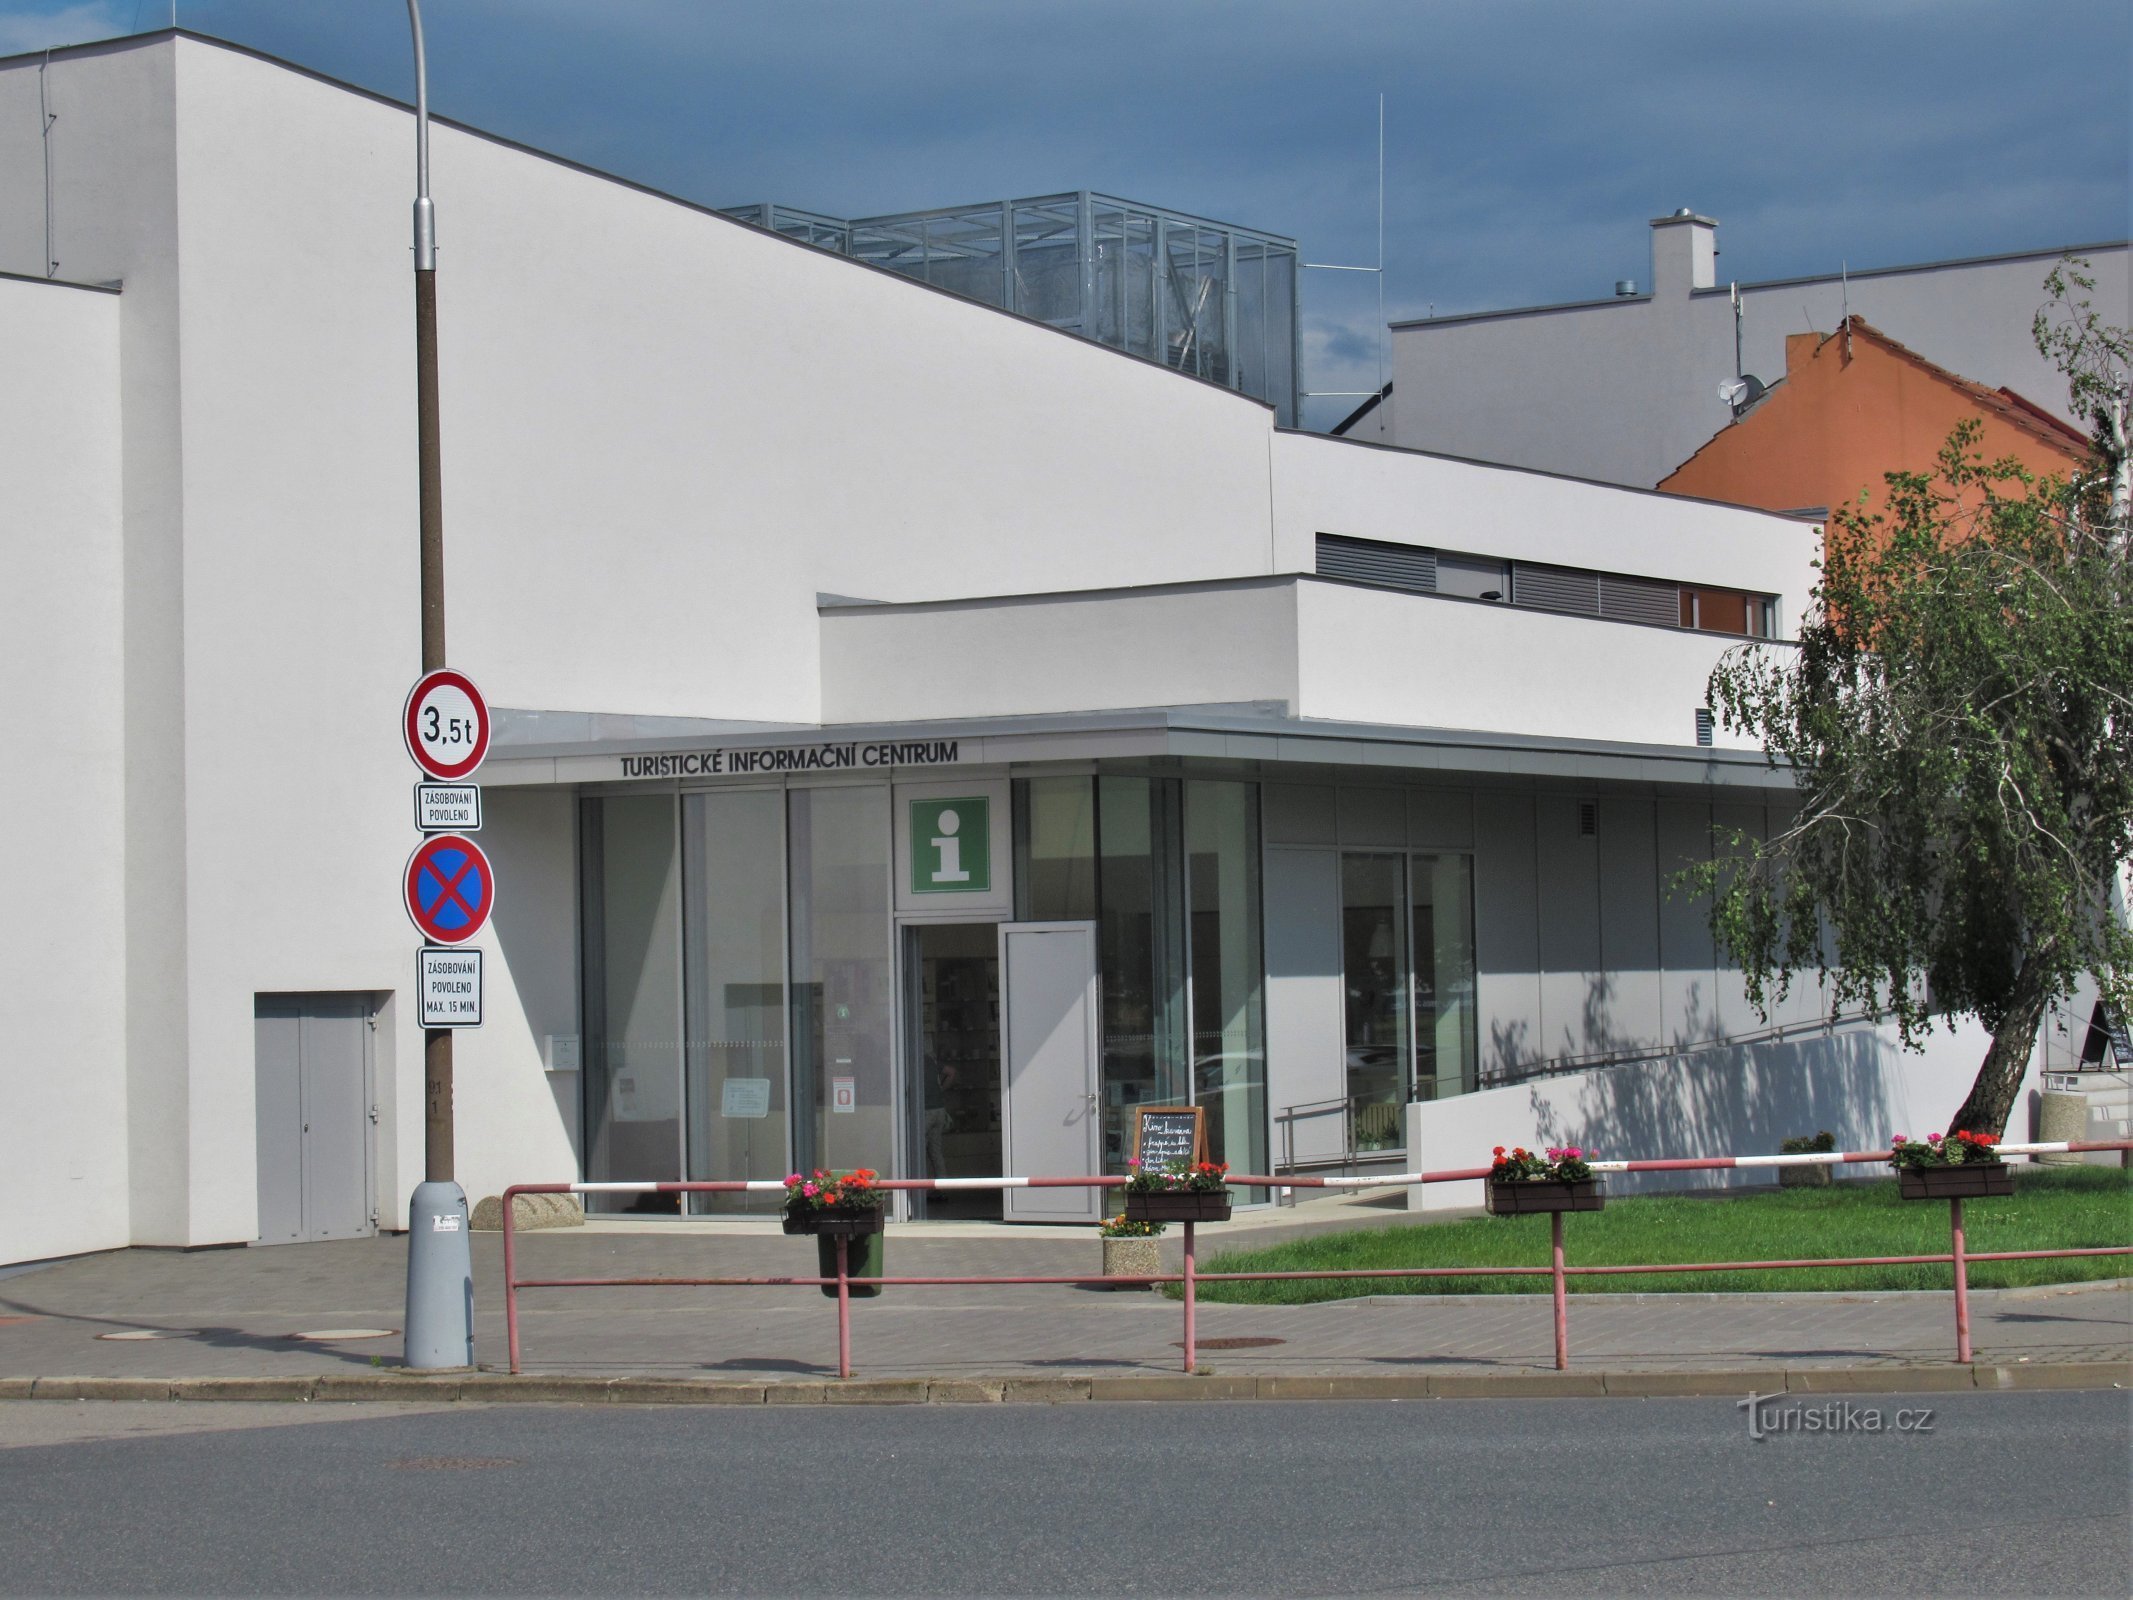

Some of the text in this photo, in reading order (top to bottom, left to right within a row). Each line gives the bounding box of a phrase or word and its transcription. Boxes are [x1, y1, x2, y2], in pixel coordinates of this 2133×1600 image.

[620, 741, 959, 777] TURISTICKÉ INFORMAČNÍ CENTRUM
[425, 790, 473, 805] ZÁSOBOVÁNÍ
[429, 809, 469, 821] POVOLENO
[427, 959, 476, 974] ZÁSOBOVÁNÍ
[432, 981, 472, 993] POVOLENO
[426, 1001, 477, 1013] MAX. 15 MIN.
[1143, 1114, 1164, 1132] Kino
